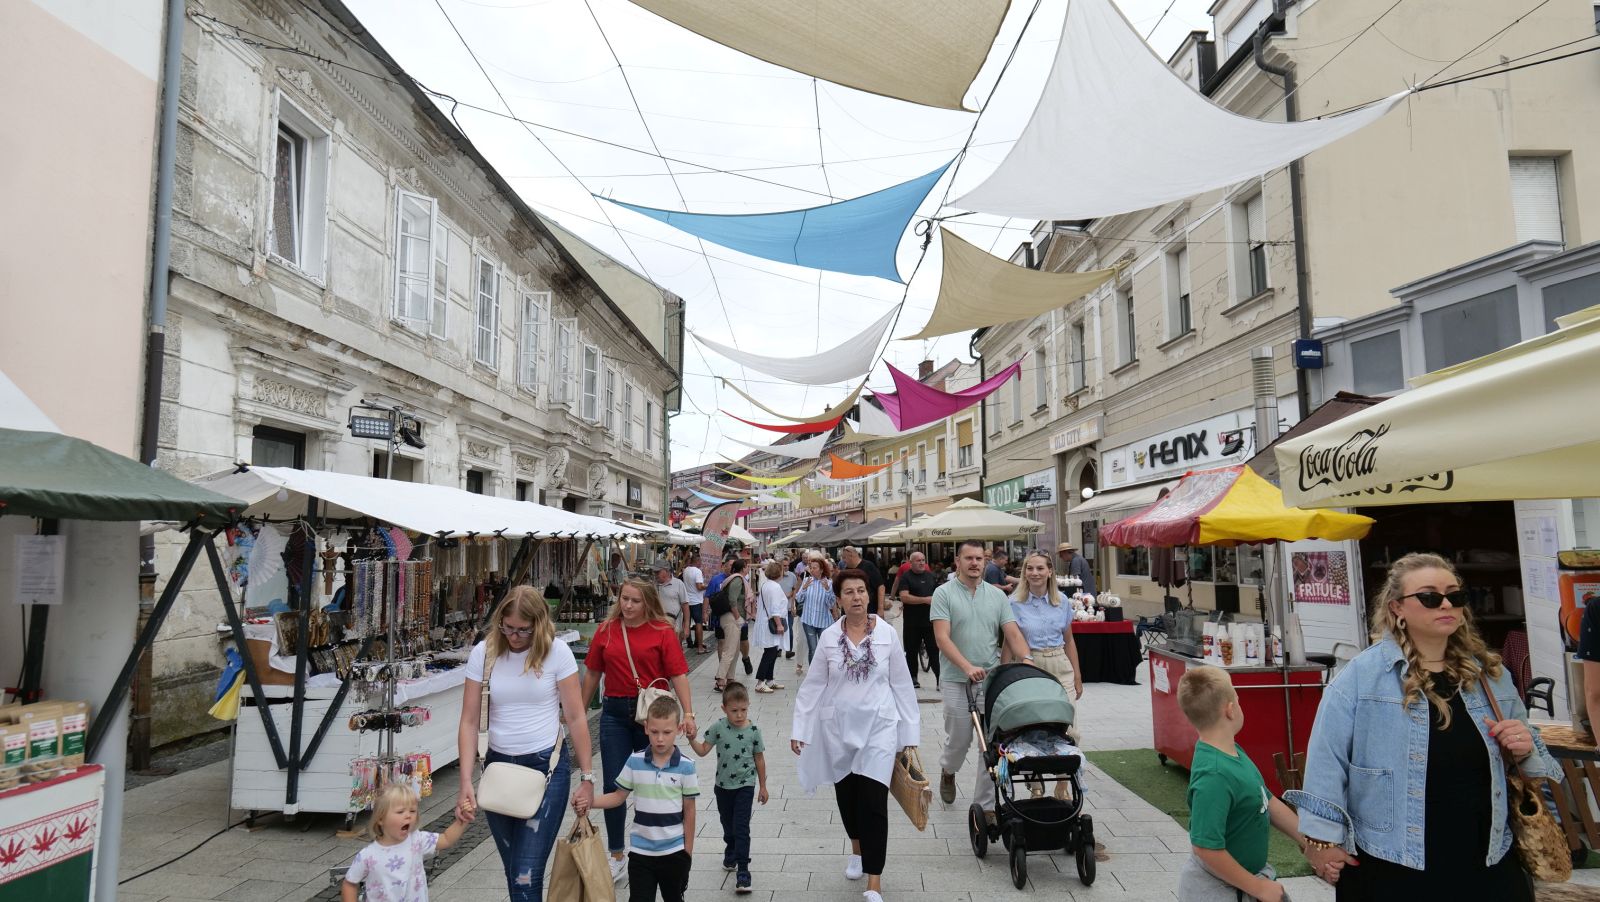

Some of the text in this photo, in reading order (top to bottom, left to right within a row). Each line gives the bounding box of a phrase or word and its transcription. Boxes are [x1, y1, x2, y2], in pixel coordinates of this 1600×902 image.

[1067, 427, 1080, 446] CITY
[1149, 429, 1209, 468] FENIX
[987, 481, 1020, 507] MODA
[1299, 582, 1344, 600] FRITULE
